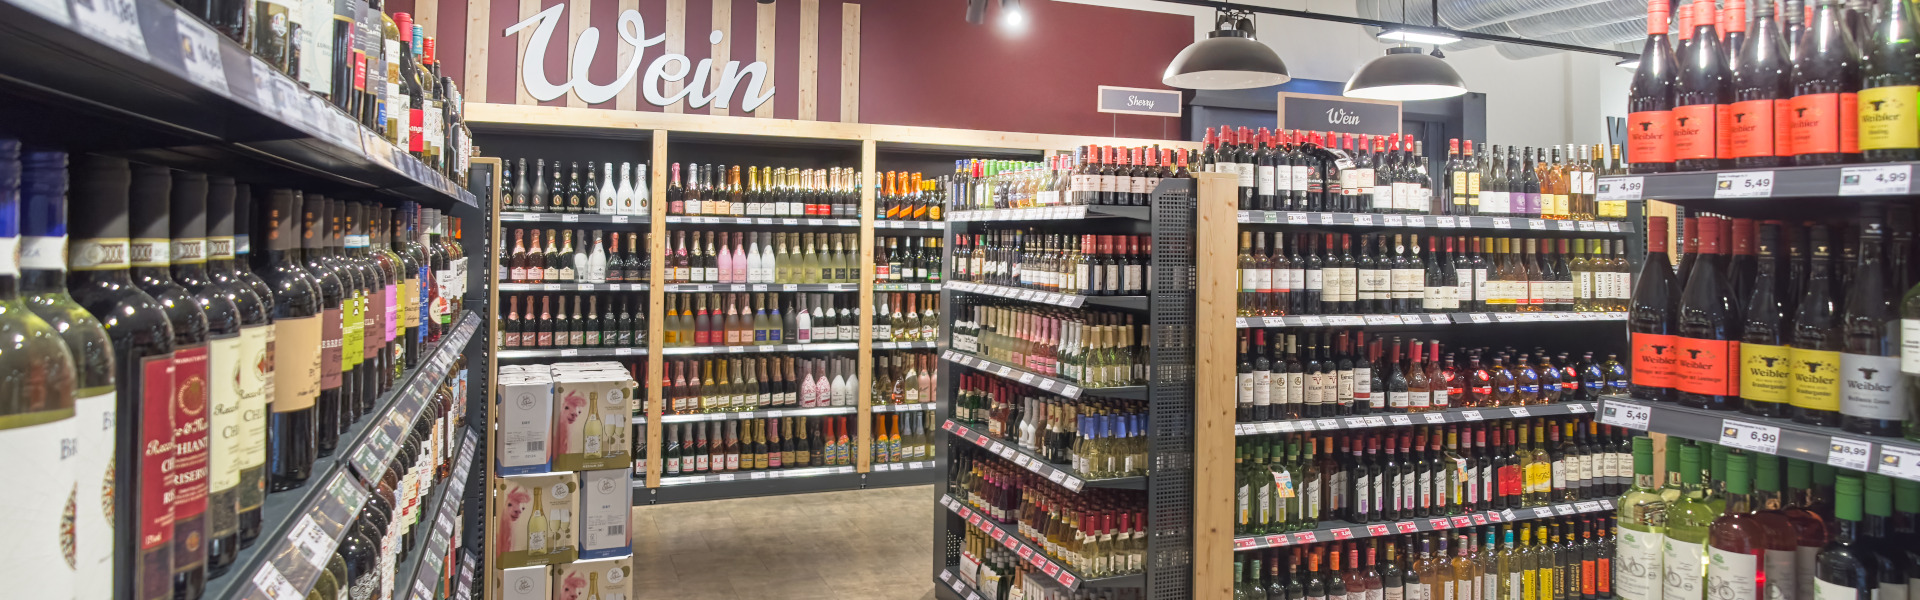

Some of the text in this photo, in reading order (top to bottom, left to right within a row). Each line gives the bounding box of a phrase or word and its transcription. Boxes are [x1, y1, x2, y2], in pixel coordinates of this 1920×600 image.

[502, 3, 775, 112] Wein
[1127, 94, 1154, 110] Sherry
[1326, 107, 1360, 126] Wein
[1862, 114, 1901, 122] Weibler
[1875, 172, 1907, 183] 4,99
[1620, 182, 1641, 192] 4,99
[1744, 178, 1770, 189] 5,49
[1642, 355, 1677, 365] Weibler
[1680, 360, 1713, 370] Weibler
[1750, 367, 1790, 379] Weibler
[1795, 373, 1835, 385] Weibler
[1847, 380, 1893, 392] Weibler
[1626, 410, 1648, 421] 5,49
[1750, 431, 1776, 443] 6,99
[1843, 445, 1866, 456] 8,99
